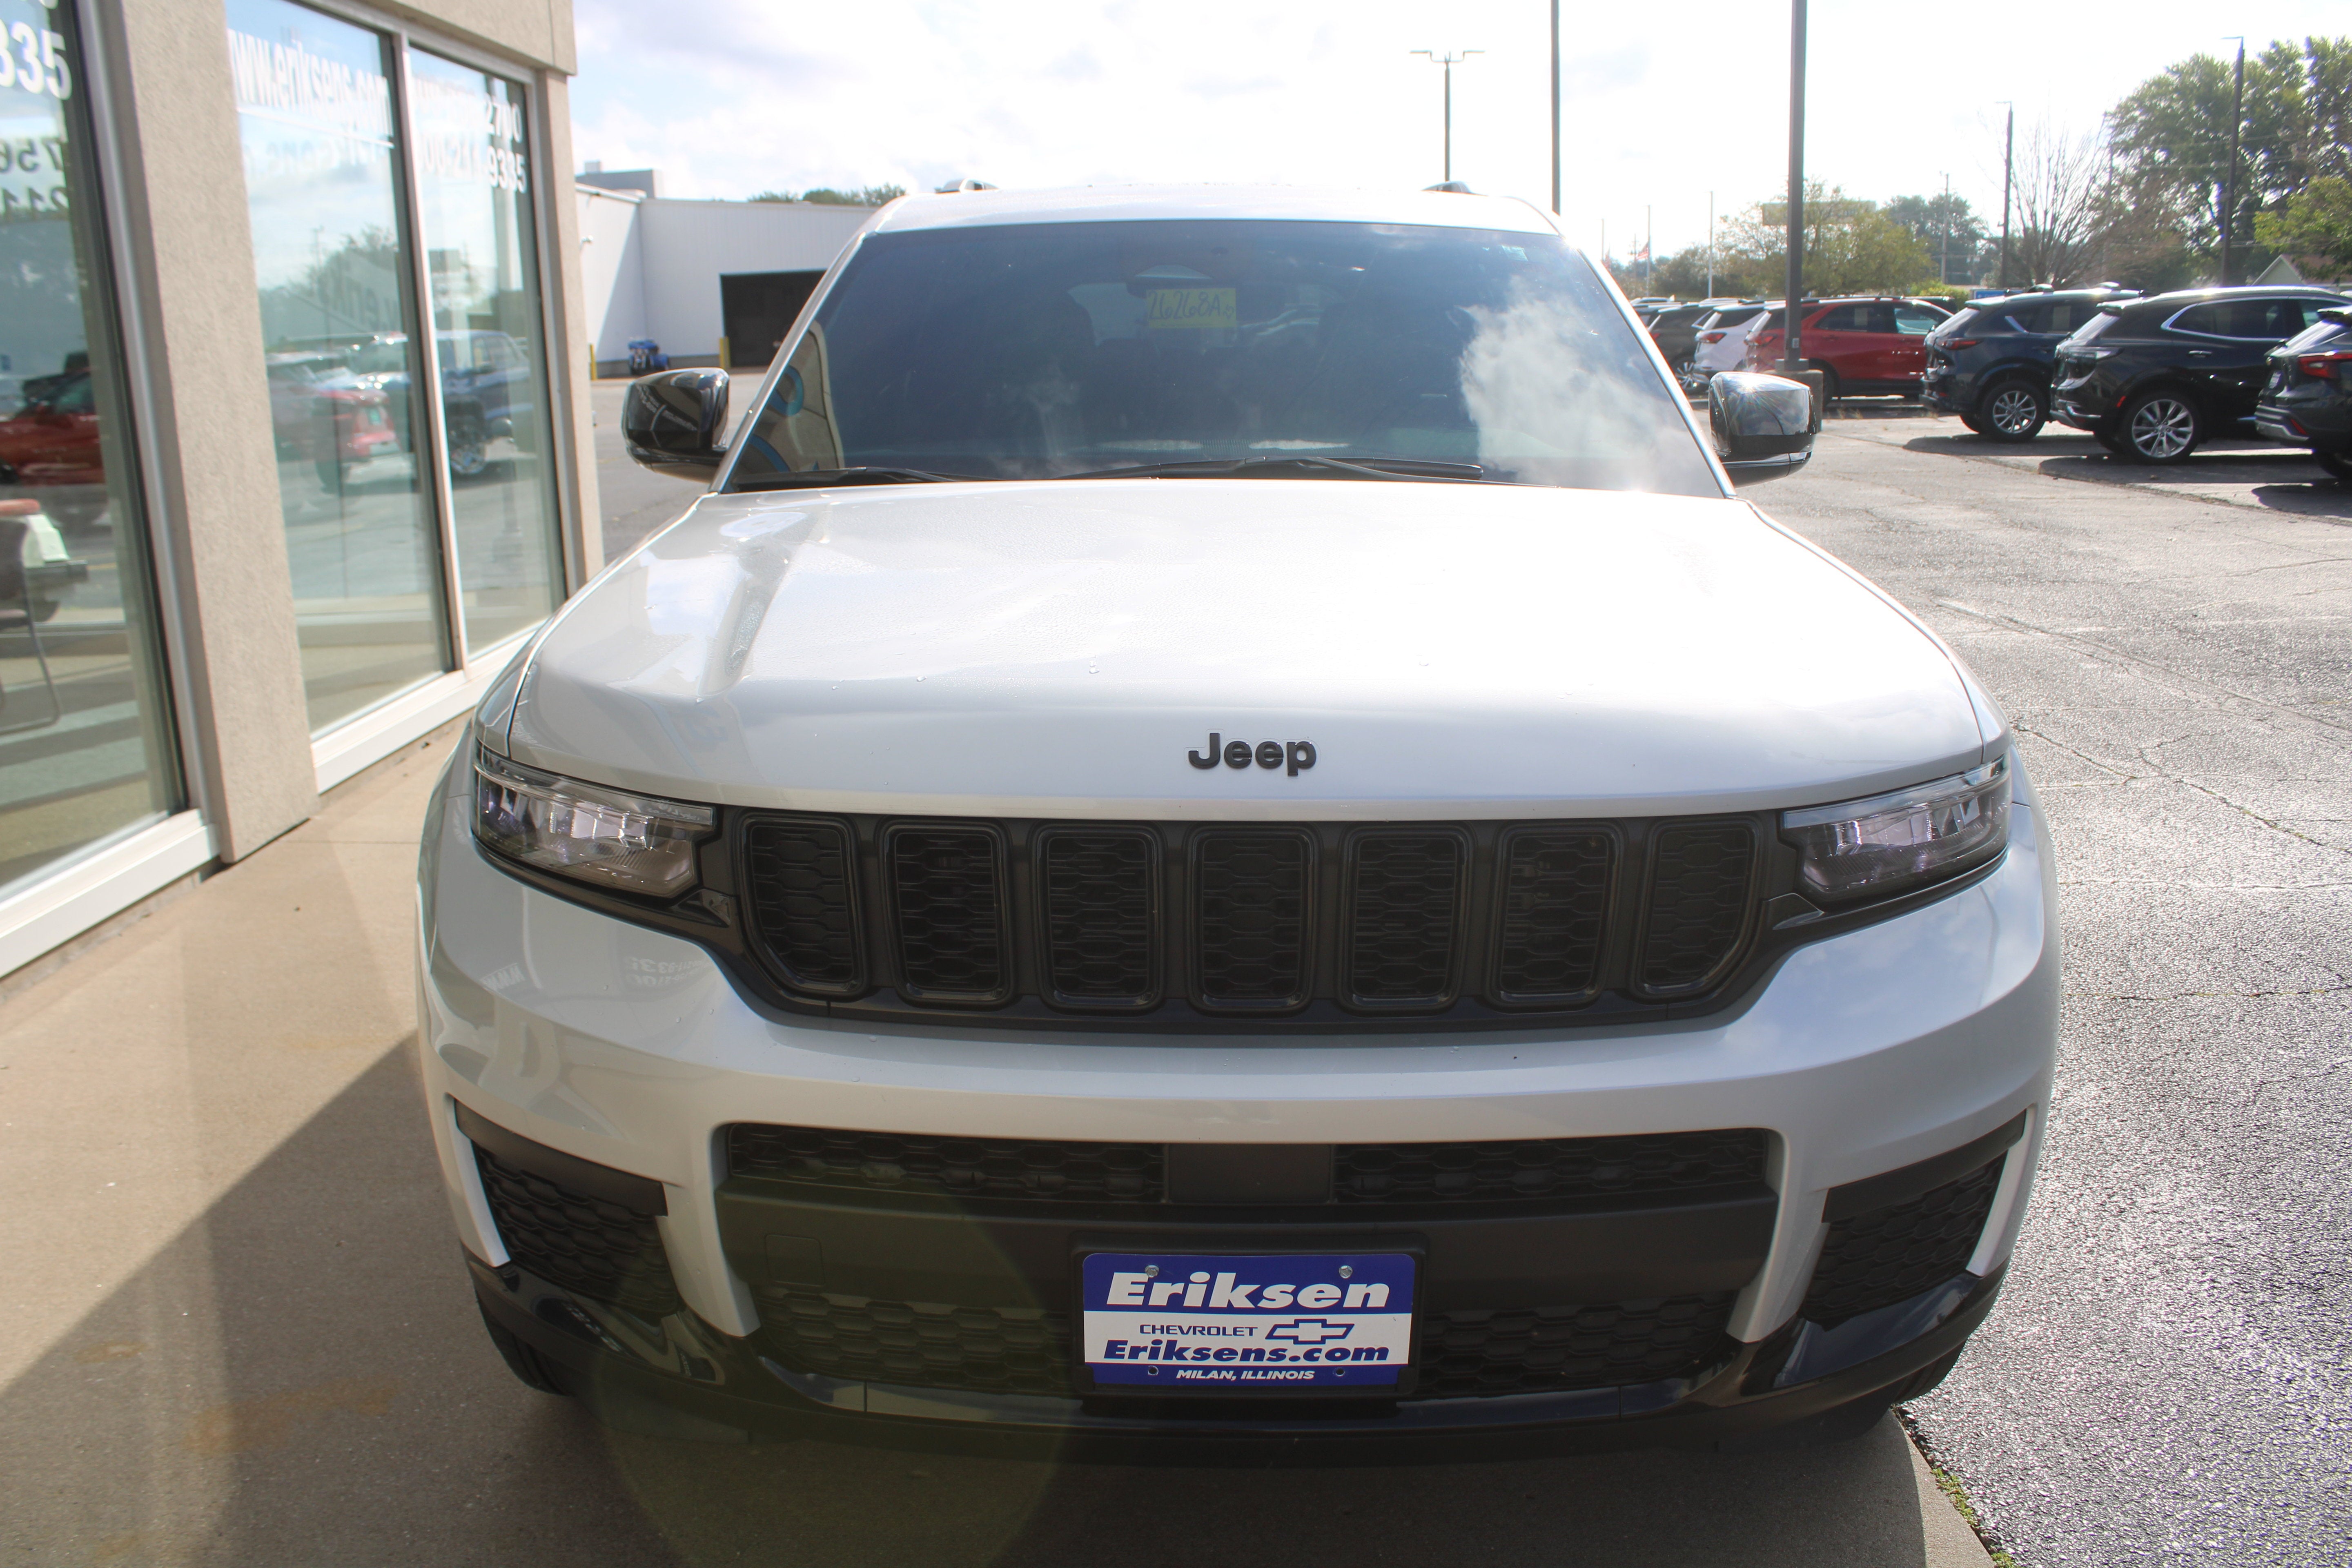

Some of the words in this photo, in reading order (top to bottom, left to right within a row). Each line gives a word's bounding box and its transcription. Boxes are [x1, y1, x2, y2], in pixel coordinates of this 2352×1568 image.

[1188, 733, 1317, 776] Jeep
[1106, 1272, 1390, 1308] Eriksen
[1140, 1324, 1258, 1336] CHEVROLET
[1103, 1339, 1389, 1362] Eriksens.com
[1176, 1370, 1237, 1381] MILAN,
[1241, 1370, 1315, 1380] ILLINOIS
